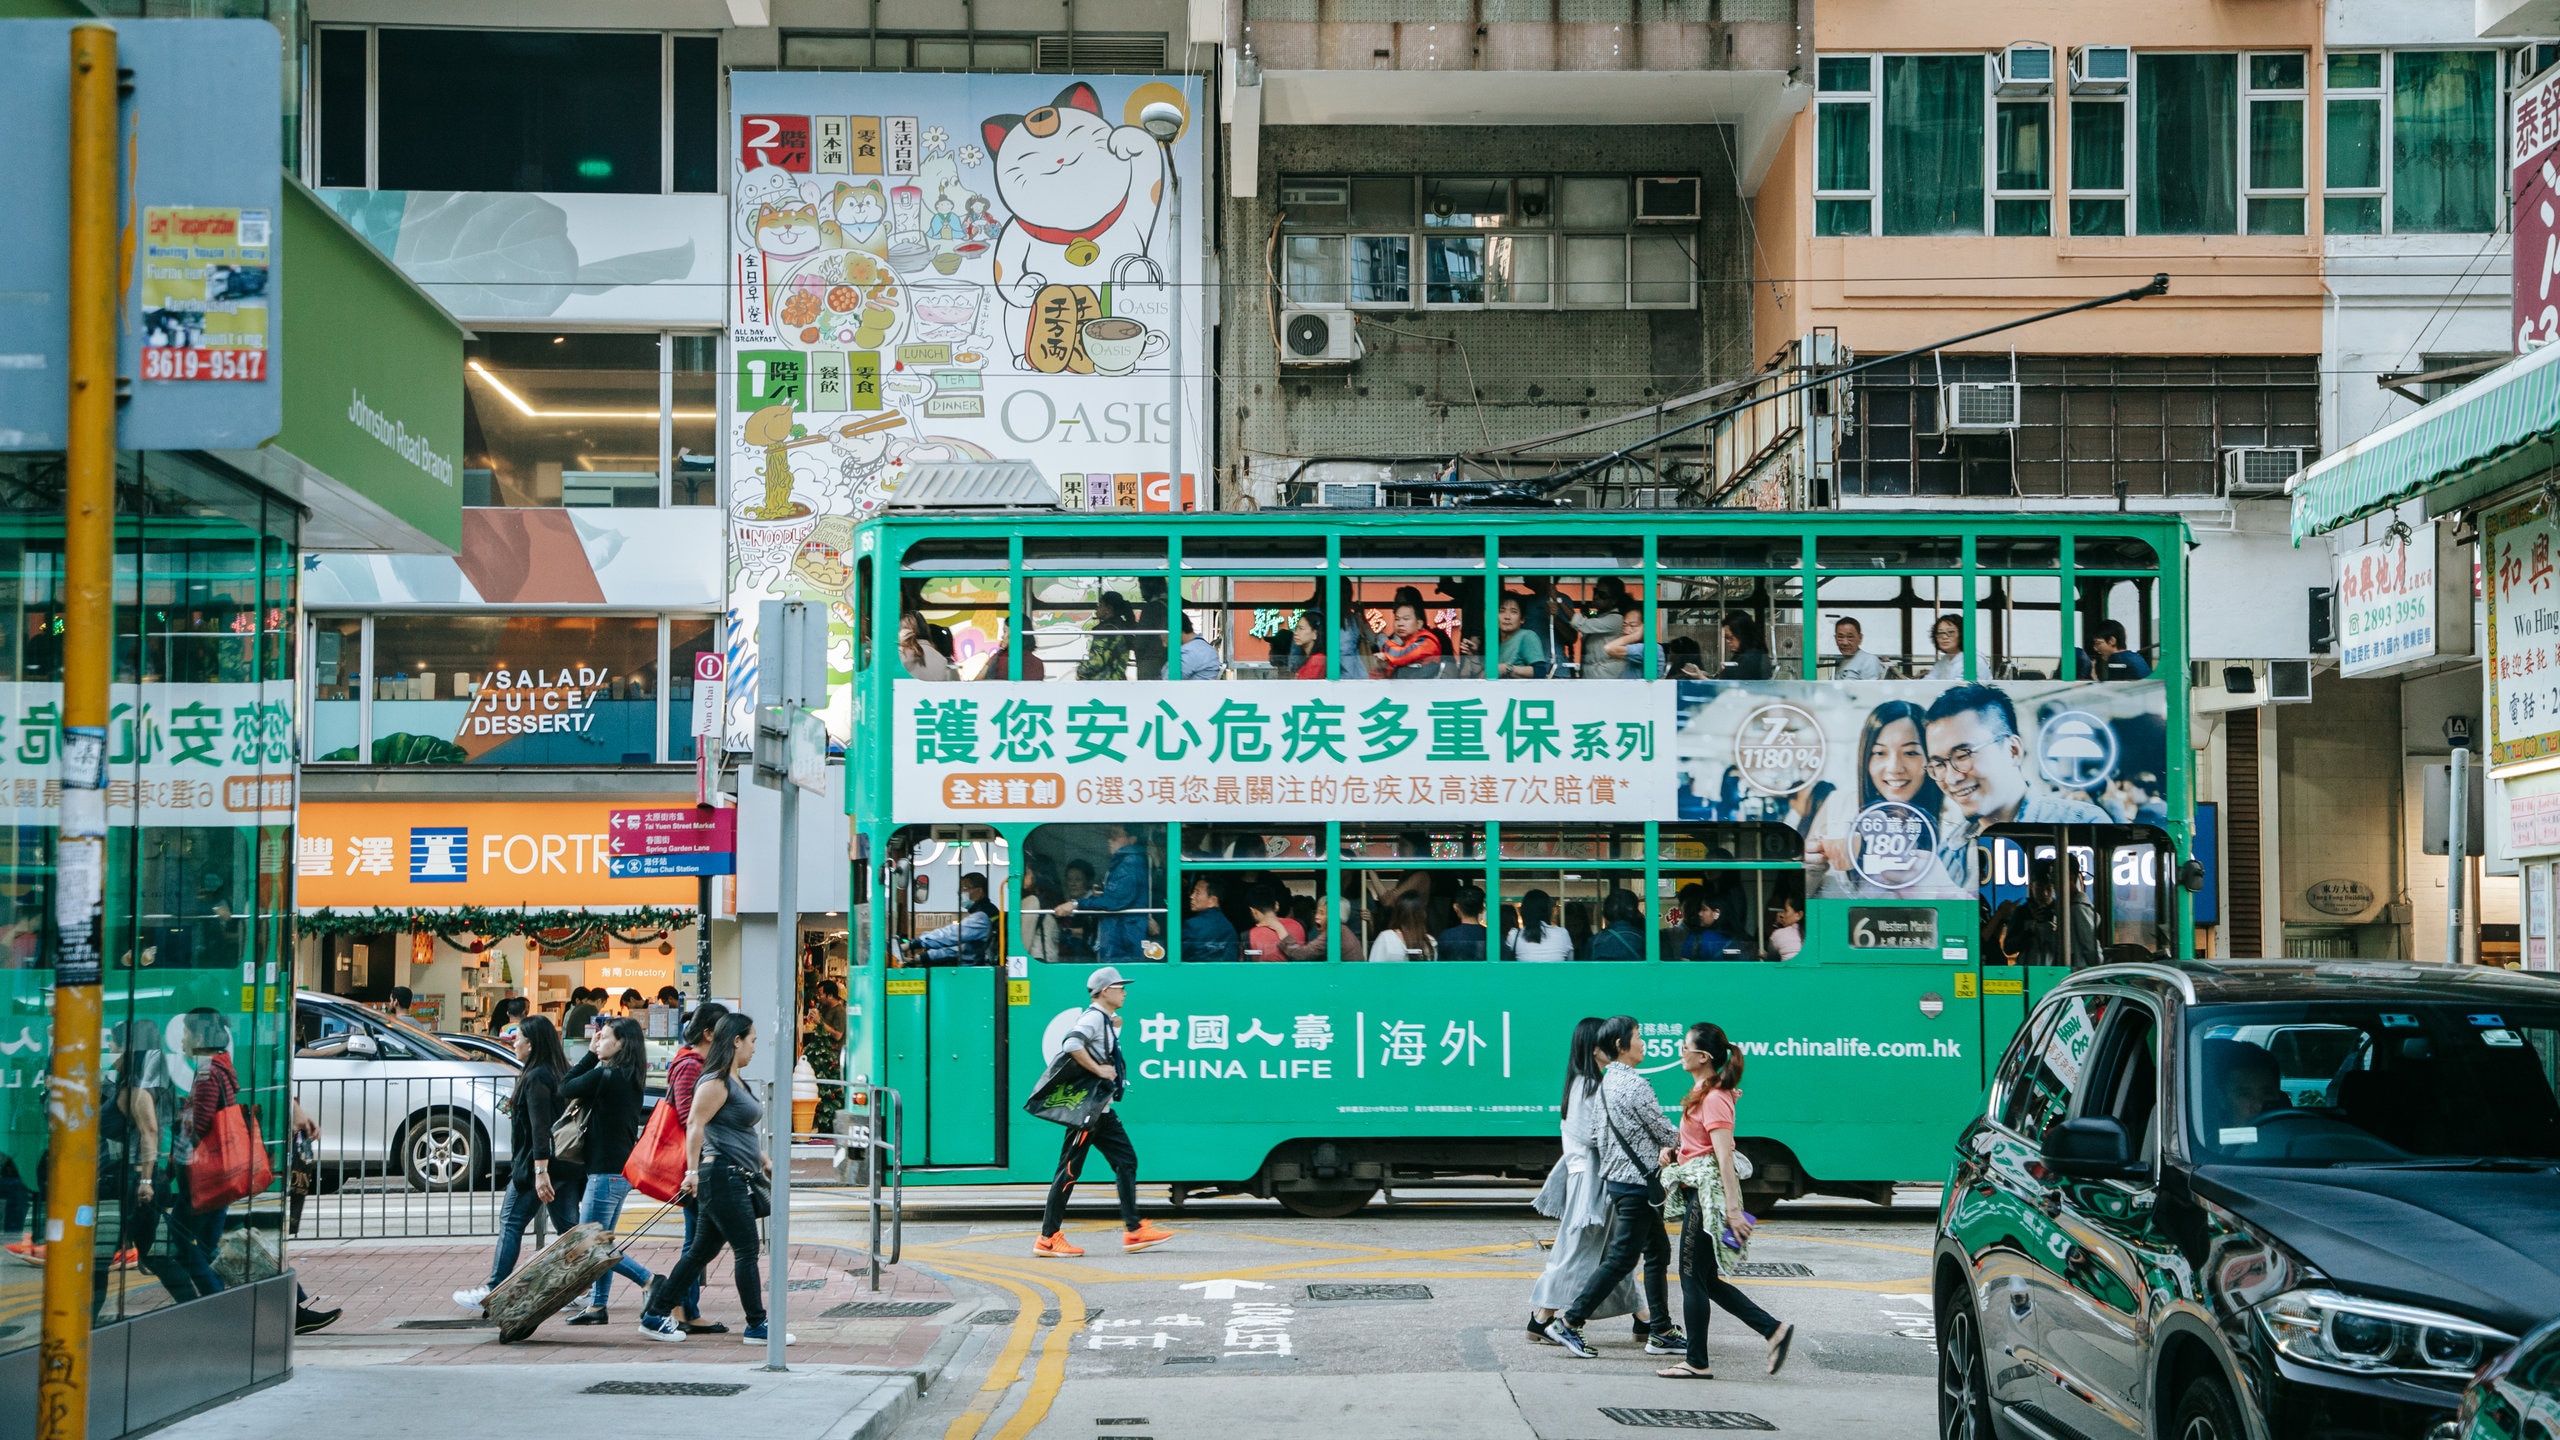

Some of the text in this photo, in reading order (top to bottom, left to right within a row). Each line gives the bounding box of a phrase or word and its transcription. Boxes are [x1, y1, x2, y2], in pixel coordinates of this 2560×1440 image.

[824, 123, 842, 165] 日本酒
[857, 129, 876, 158] 零食
[895, 120, 912, 172] 生活百貨
[745, 253, 761, 324] 全日早餐
[1118, 298, 1169, 315] OASIS
[904, 348, 944, 360] LUNCH
[1091, 342, 1132, 356] OASIS
[147, 351, 262, 379] 3619-9547
[820, 366, 839, 394] 餐飲
[856, 366, 875, 394] 零食
[943, 375, 965, 385] TEA
[932, 399, 979, 412] DINNER
[1000, 389, 1170, 445] OASIS
[349, 388, 452, 488] Johnston Road Branch
[1063, 481, 1083, 508] 果汁
[2500, 532, 2560, 604] 和興
[2364, 596, 2425, 632] 2893 3956
[2514, 606, 2560, 642] Wo Hing
[703, 685, 714, 733] Wan Chai
[950, 777, 1057, 805] 全港首創
[672, 822, 692, 830] Street
[693, 821, 715, 829] Market
[298, 835, 396, 877] 豐澤
[482, 834, 640, 876] FORTR
[1853, 917, 1876, 947] 6
[1878, 920, 1934, 932] Western Marke
[601, 967, 667, 979] 指南 Directory
[1010, 995, 1029, 1003] EXIT
[1956, 990, 1975, 998] ONLY
[1139, 1012, 1334, 1052] 中國人壽
[1380, 1020, 1487, 1068] 海外
[1727, 1038, 1961, 1058] ww.chinalife.com.hk
[1139, 1058, 1333, 1080] CHINA LIFE
